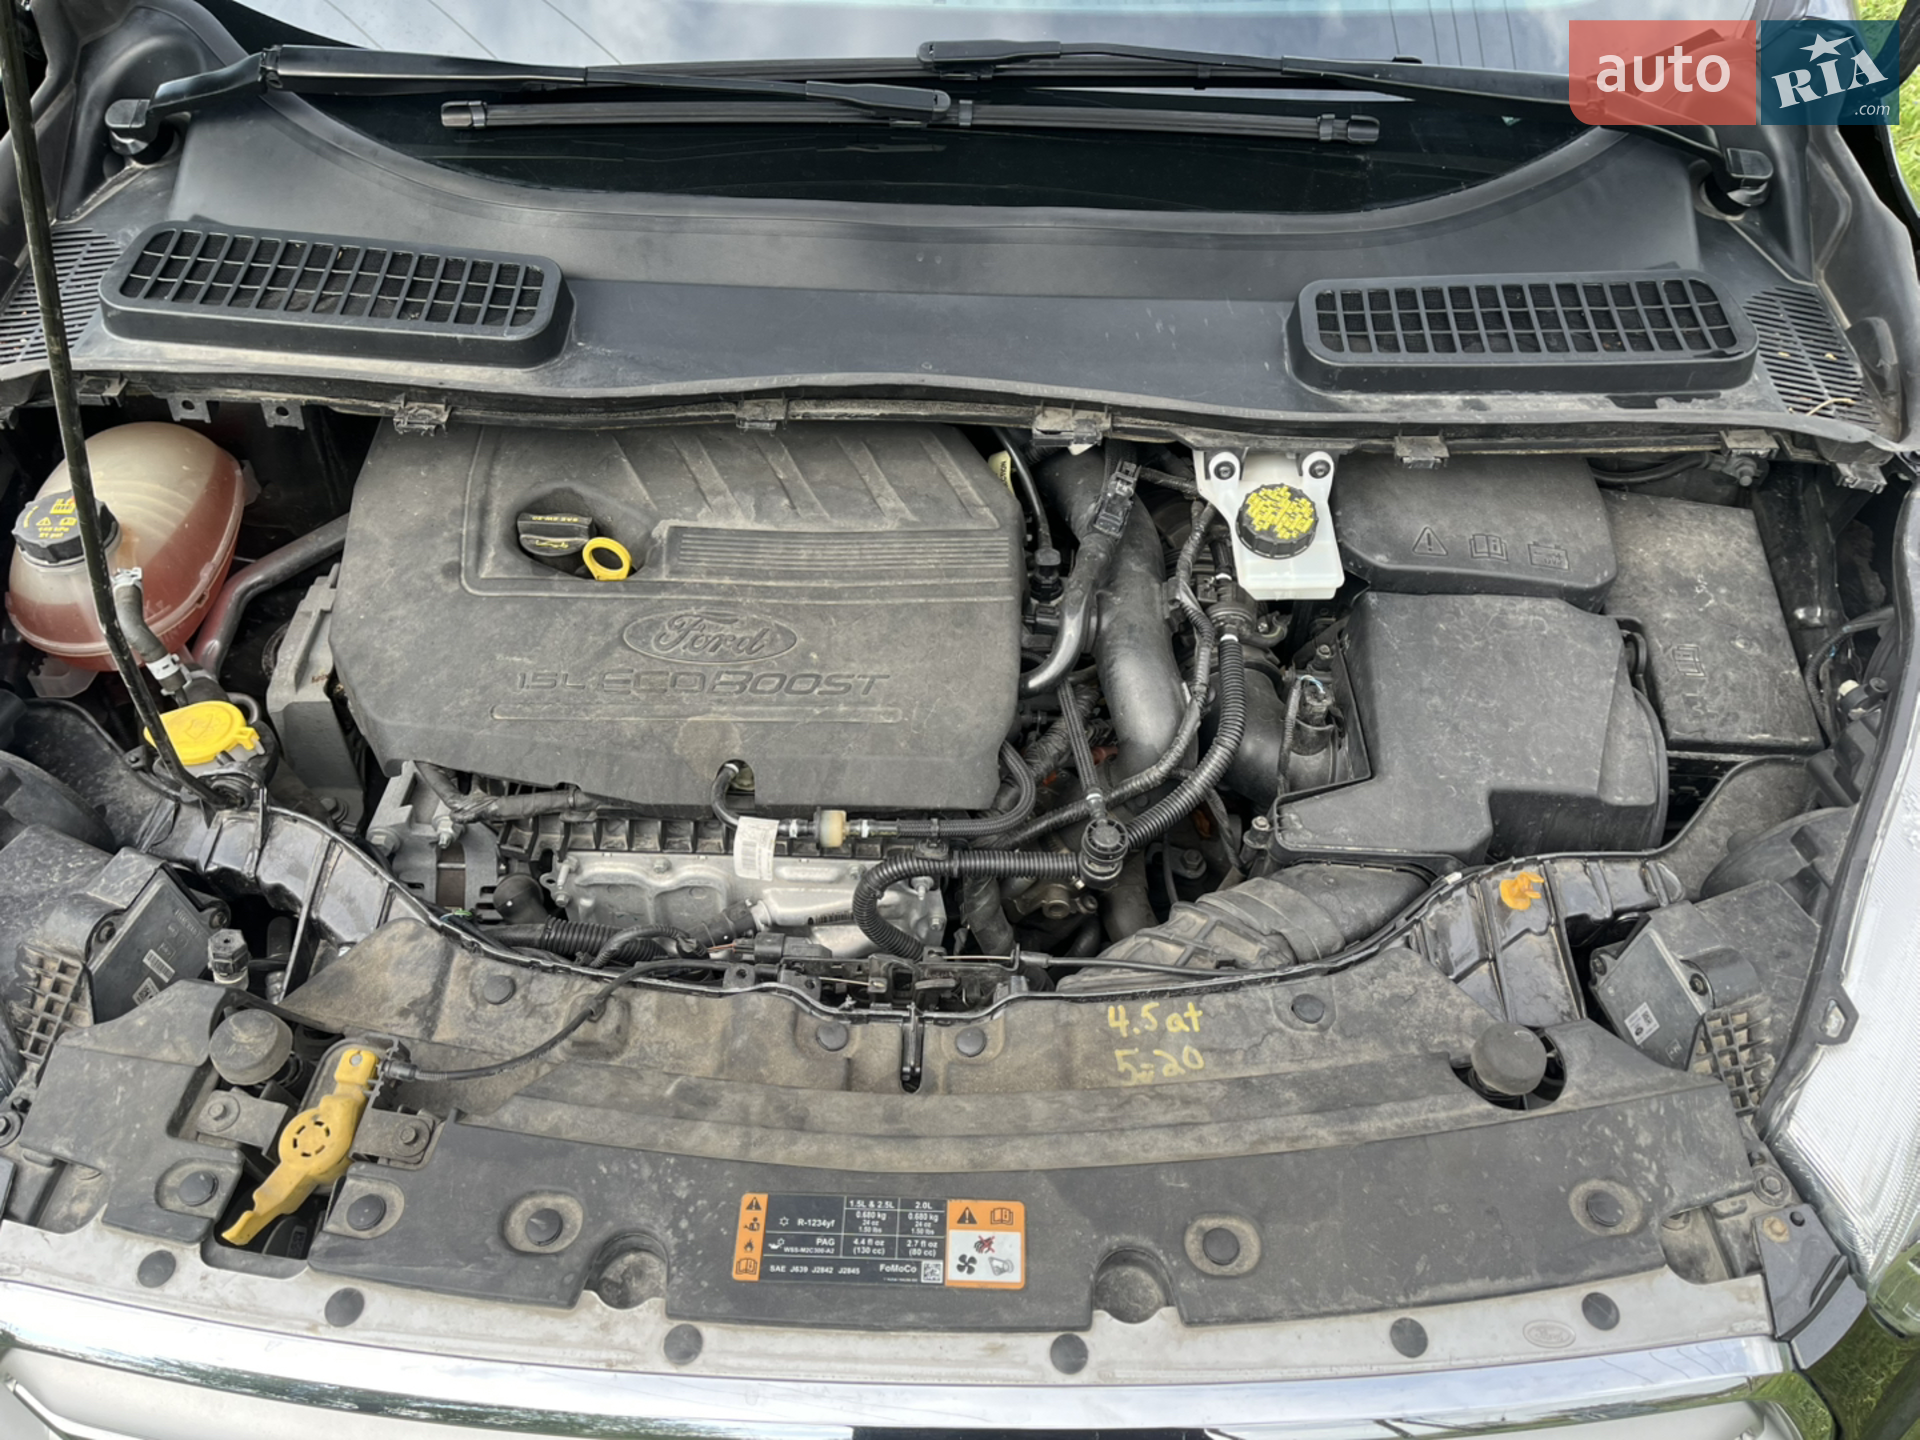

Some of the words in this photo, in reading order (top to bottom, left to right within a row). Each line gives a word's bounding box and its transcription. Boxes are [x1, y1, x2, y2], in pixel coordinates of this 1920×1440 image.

[653, 611, 770, 656] Ford
[516, 671, 586, 691] 1.5L
[849, 1199, 867, 1208] 1.5L
[877, 1200, 895, 1209] 2.5L
[915, 1201, 933, 1210] 2.0L
[876, 1211, 887, 1221] kg
[928, 1213, 939, 1223] kg
[797, 1217, 836, 1229] R-1234yf
[816, 1237, 835, 1247] PAG
[852, 1238, 866, 1246] 4.4
[874, 1239, 885, 1247] oz
[906, 1239, 919, 1248] 2.7
[871, 1247, 886, 1256] cc)
[922, 1249, 937, 1258] cc)
[769, 1264, 787, 1273] SAE
[879, 1263, 917, 1273] FoMoCo
